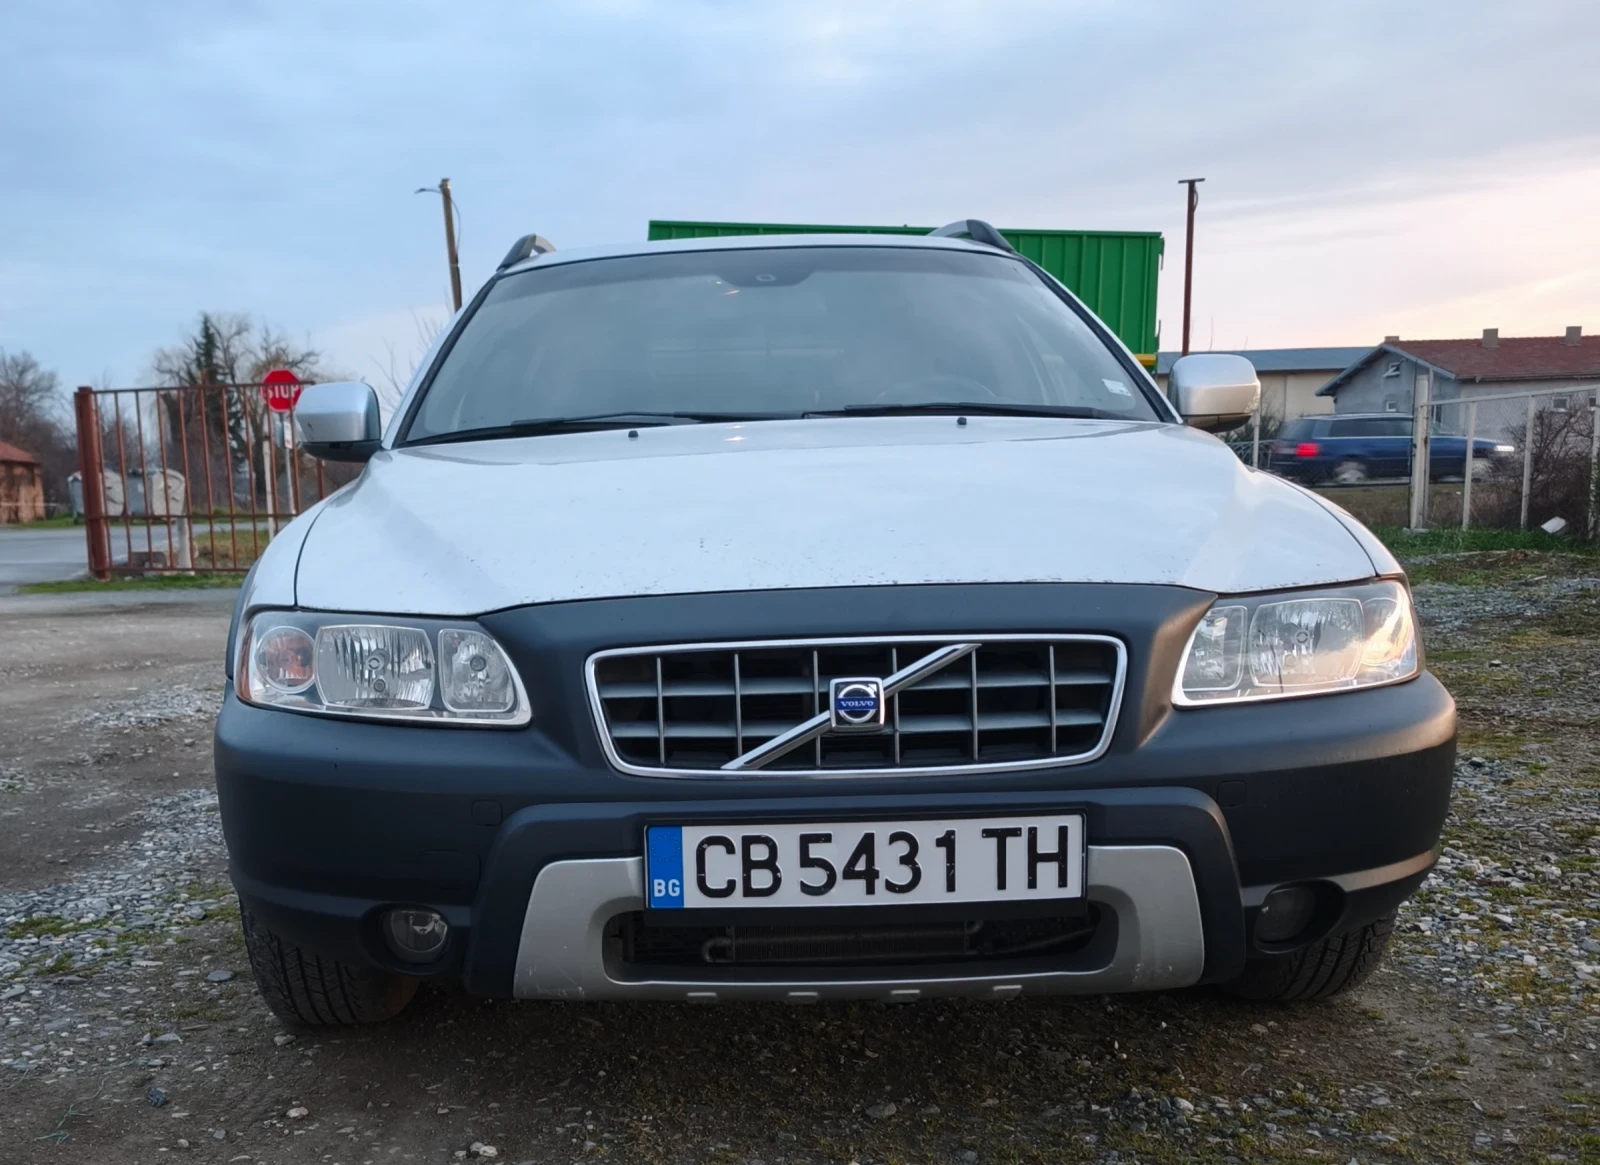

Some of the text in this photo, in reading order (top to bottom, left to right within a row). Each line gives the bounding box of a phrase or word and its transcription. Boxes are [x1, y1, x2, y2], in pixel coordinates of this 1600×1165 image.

[695, 825, 1068, 898] CB 5431 TH
[653, 879, 681, 898] BG
